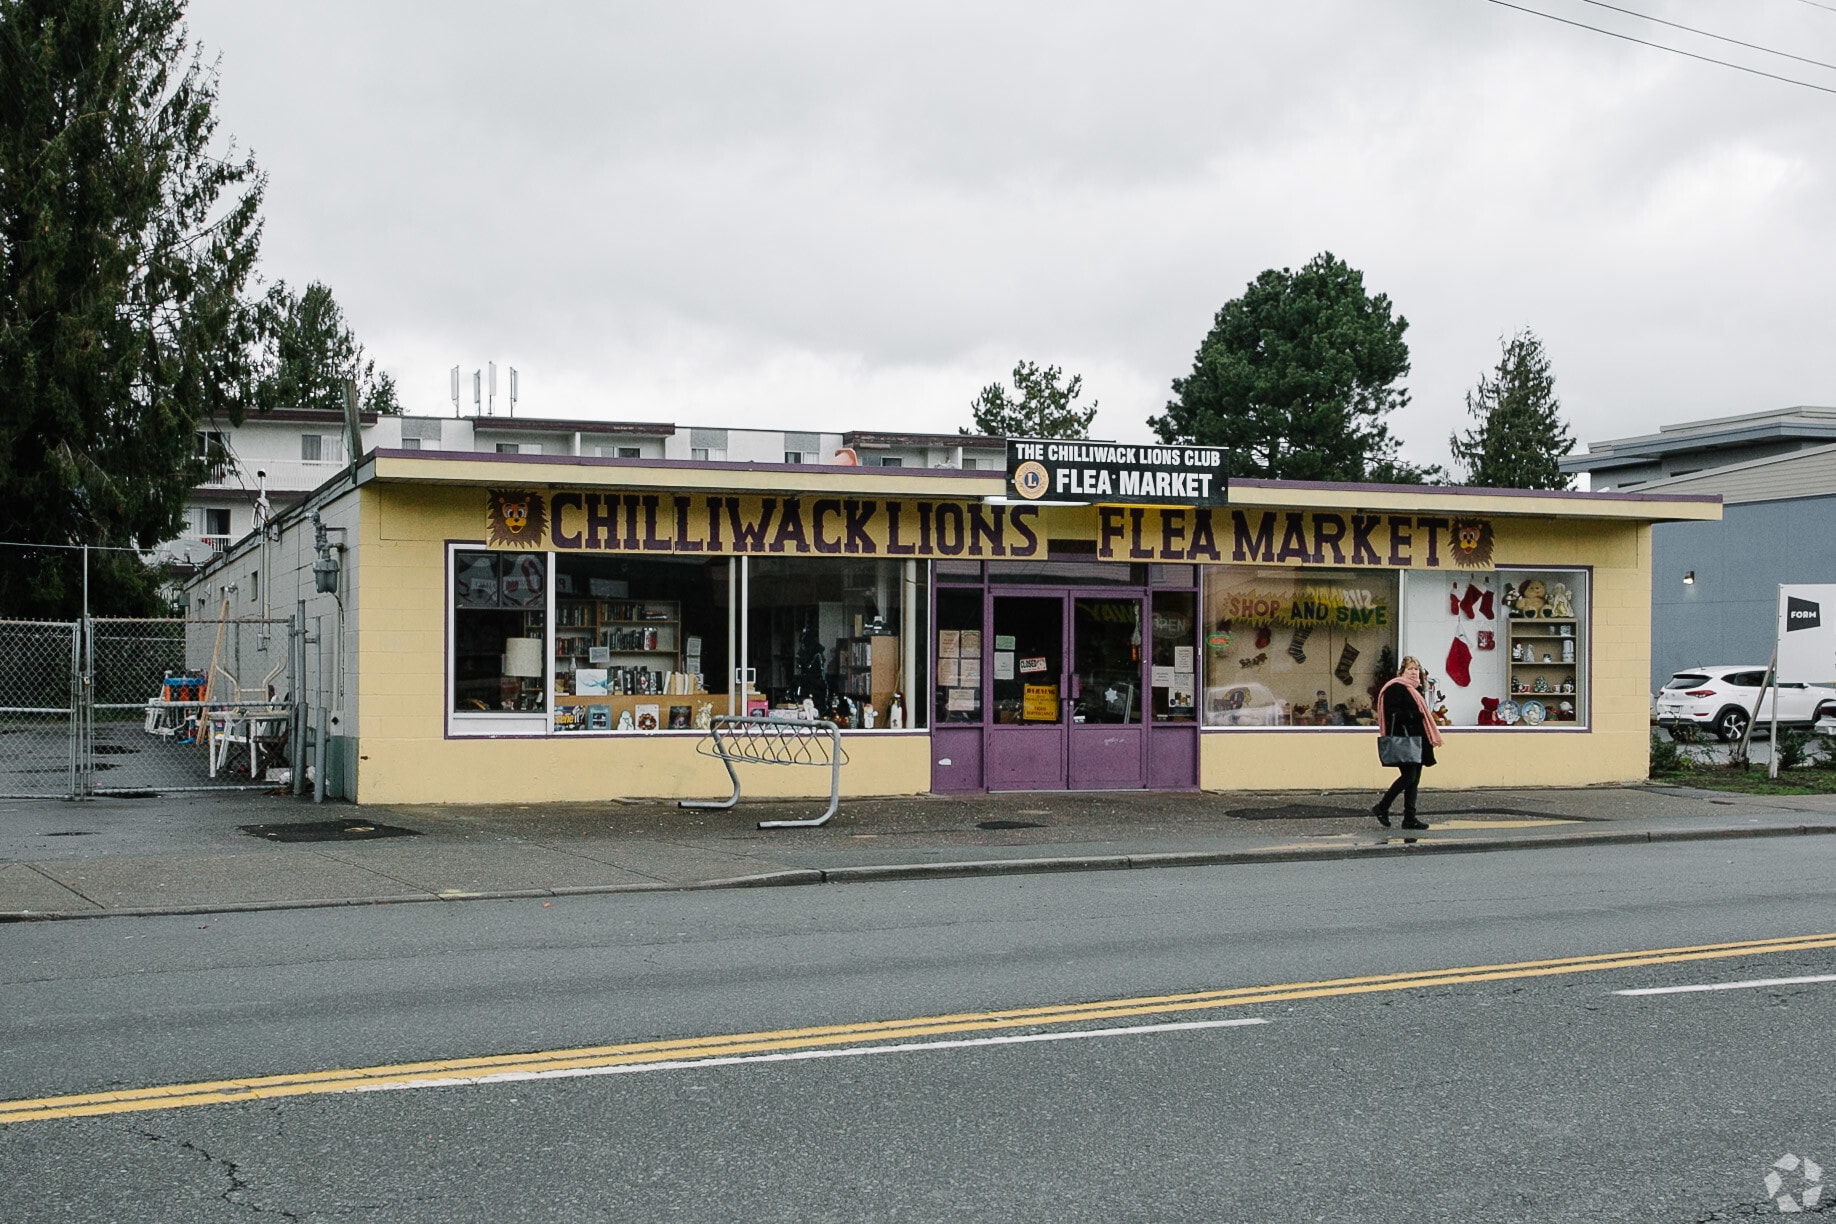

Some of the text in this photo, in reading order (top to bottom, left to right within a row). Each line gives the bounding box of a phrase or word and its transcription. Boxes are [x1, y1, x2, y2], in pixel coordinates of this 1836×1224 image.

[1015, 443, 1221, 467] THE CHILLIWACK LIONS CLUB
[1056, 468, 1213, 498] FLEA MARKET
[550, 492, 1449, 567] CHILLIWACK LIONS FLEA MARKET
[1229, 597, 1388, 625] SHOP AND SAVE
[1790, 611, 1817, 619] FORM
